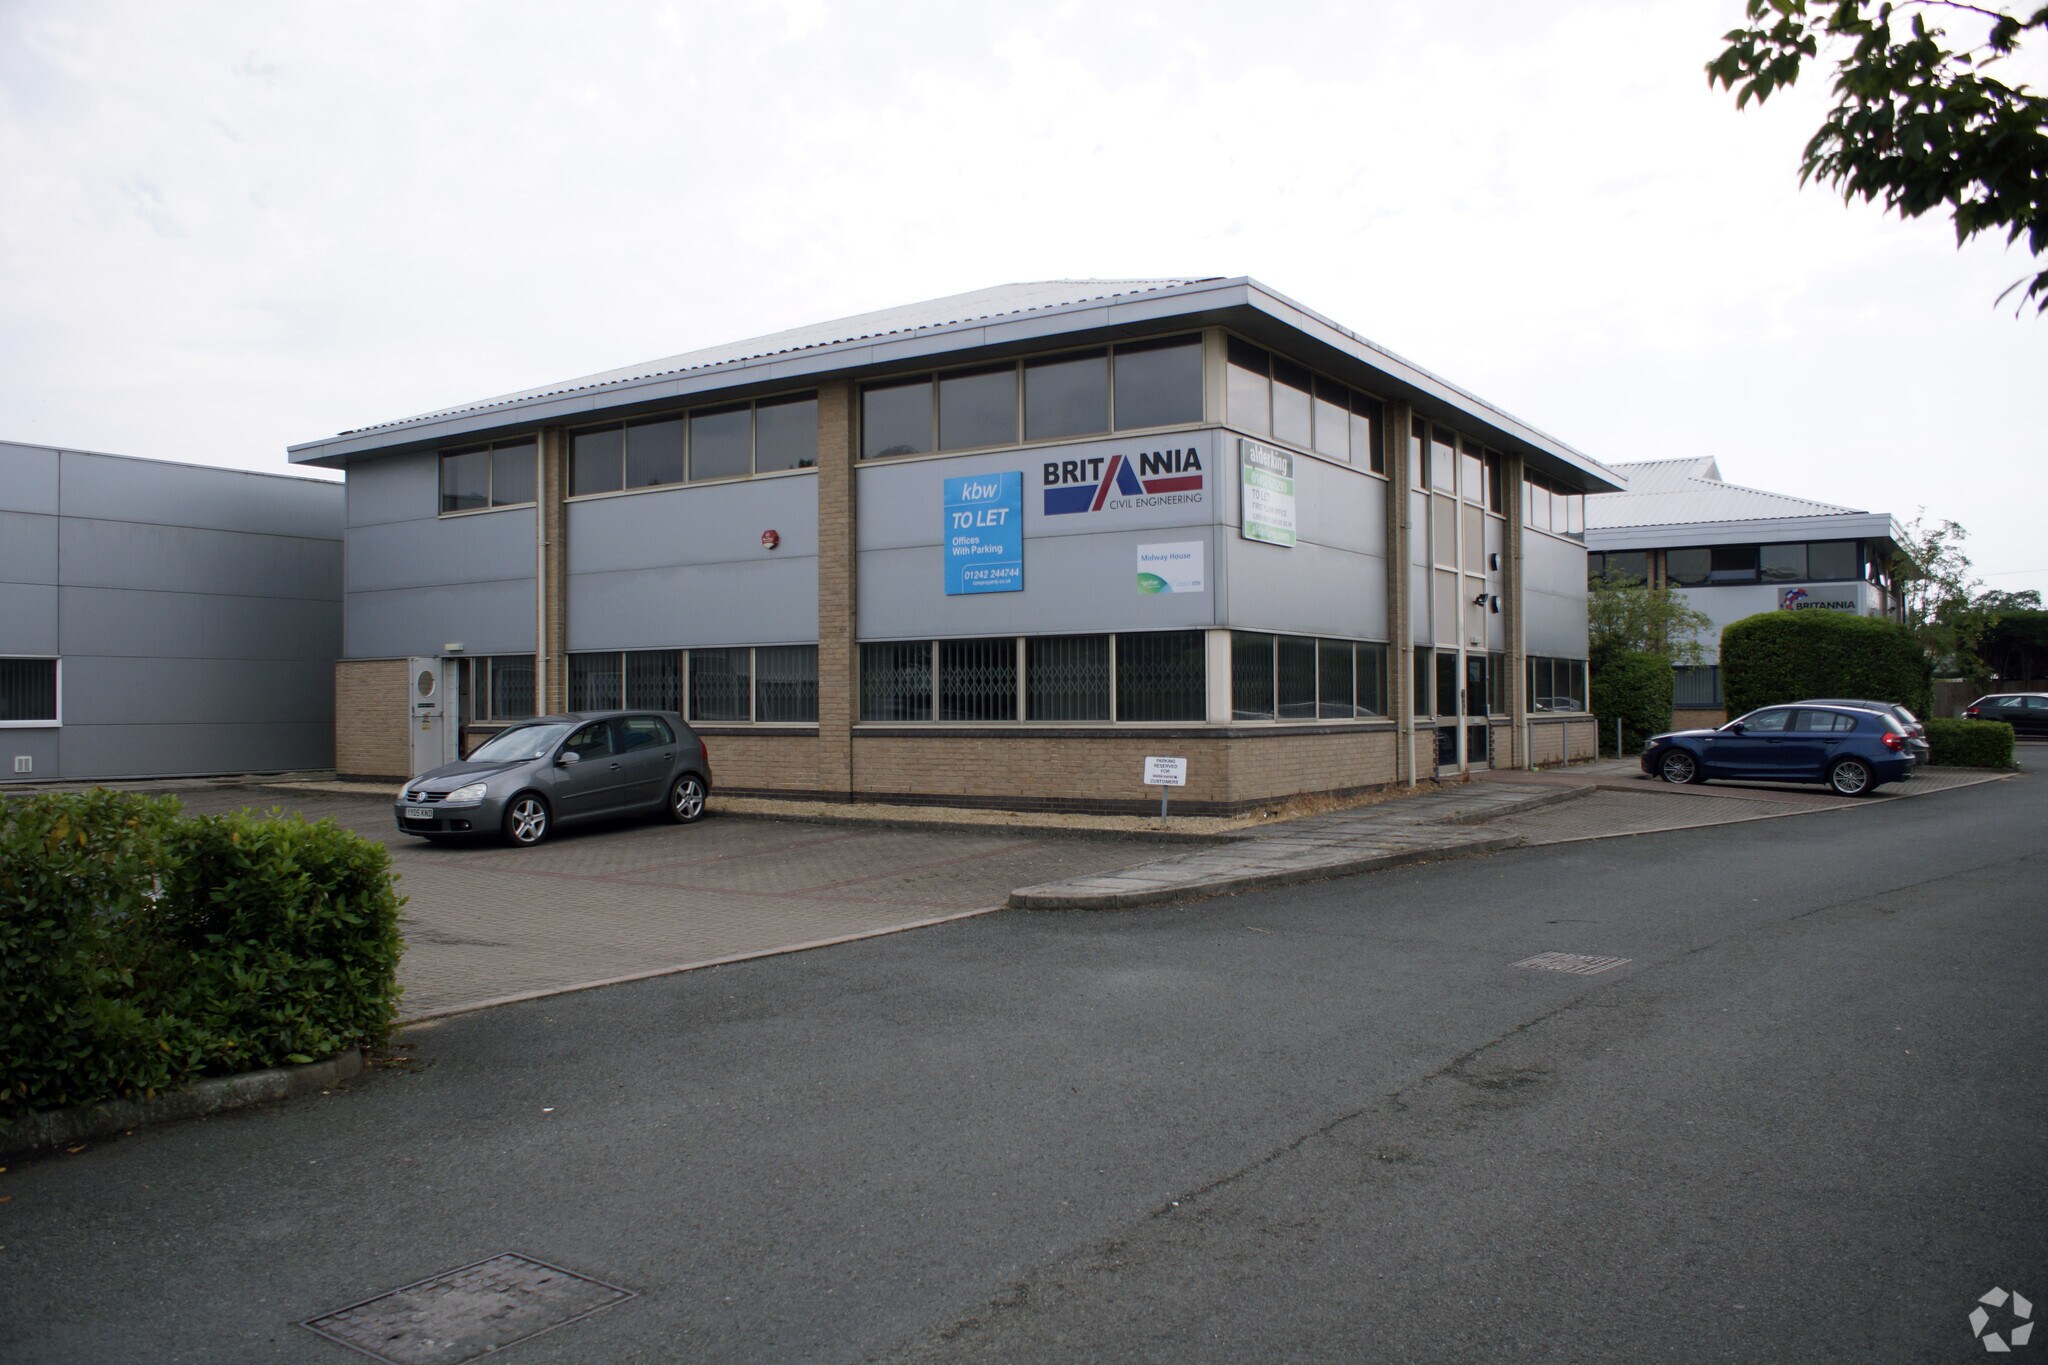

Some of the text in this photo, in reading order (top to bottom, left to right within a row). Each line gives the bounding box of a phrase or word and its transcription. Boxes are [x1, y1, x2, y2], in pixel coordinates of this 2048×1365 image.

[1250, 445, 1287, 476] alderking
[1043, 447, 1202, 505] BRITANNIA
[961, 482, 998, 501] kbw
[1252, 489, 1270, 502] TO LET
[1109, 493, 1203, 510] CIVIL ENGINEERING
[952, 508, 1009, 529] TO LET
[952, 537, 980, 546] Offices
[952, 544, 1003, 556] With Parking
[1141, 554, 1168, 562] Midway
[964, 567, 1020, 580] 01242 244744
[1796, 601, 1856, 610] BRITANNIA
